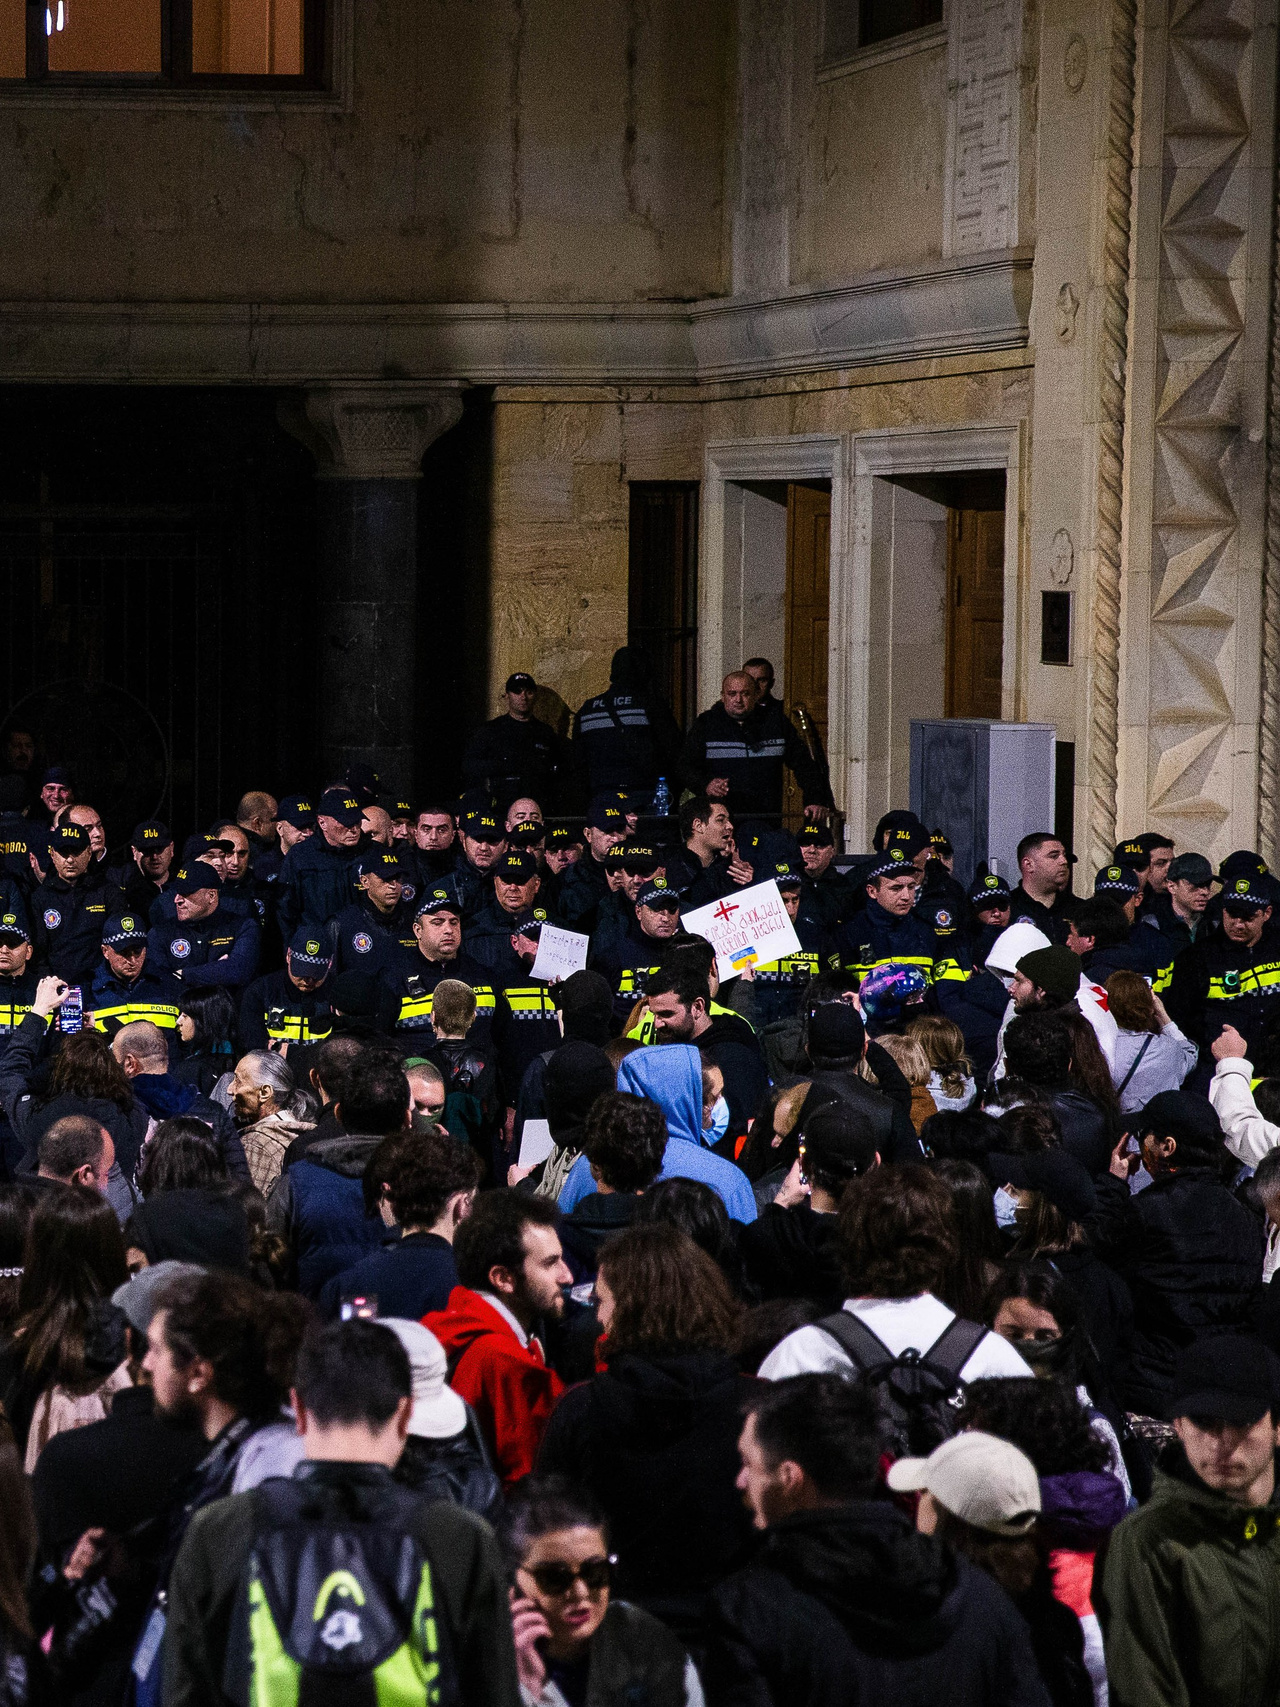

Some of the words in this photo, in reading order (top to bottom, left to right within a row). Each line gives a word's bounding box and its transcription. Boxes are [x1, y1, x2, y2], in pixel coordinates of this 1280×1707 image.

[297, 802, 312, 812] შსს
[343, 799, 358, 809] შსს
[605, 808, 620, 817] შსს
[481, 817, 496, 827] შსს
[518, 823, 535, 832] შსს
[804, 825, 819, 834] შსს
[62, 827, 81, 838] შსს
[143, 828, 159, 838] შსს
[552, 829, 568, 837] შსს
[896, 830, 911, 840] შსს
[1124, 844, 1143, 853] შსს
[382, 854, 398, 863] შსს
[507, 856, 522, 866] შსს
[791, 952, 814, 960] OLICE
[1262, 960, 1280, 971] POLI
[151, 1006, 176, 1014] POLICE
